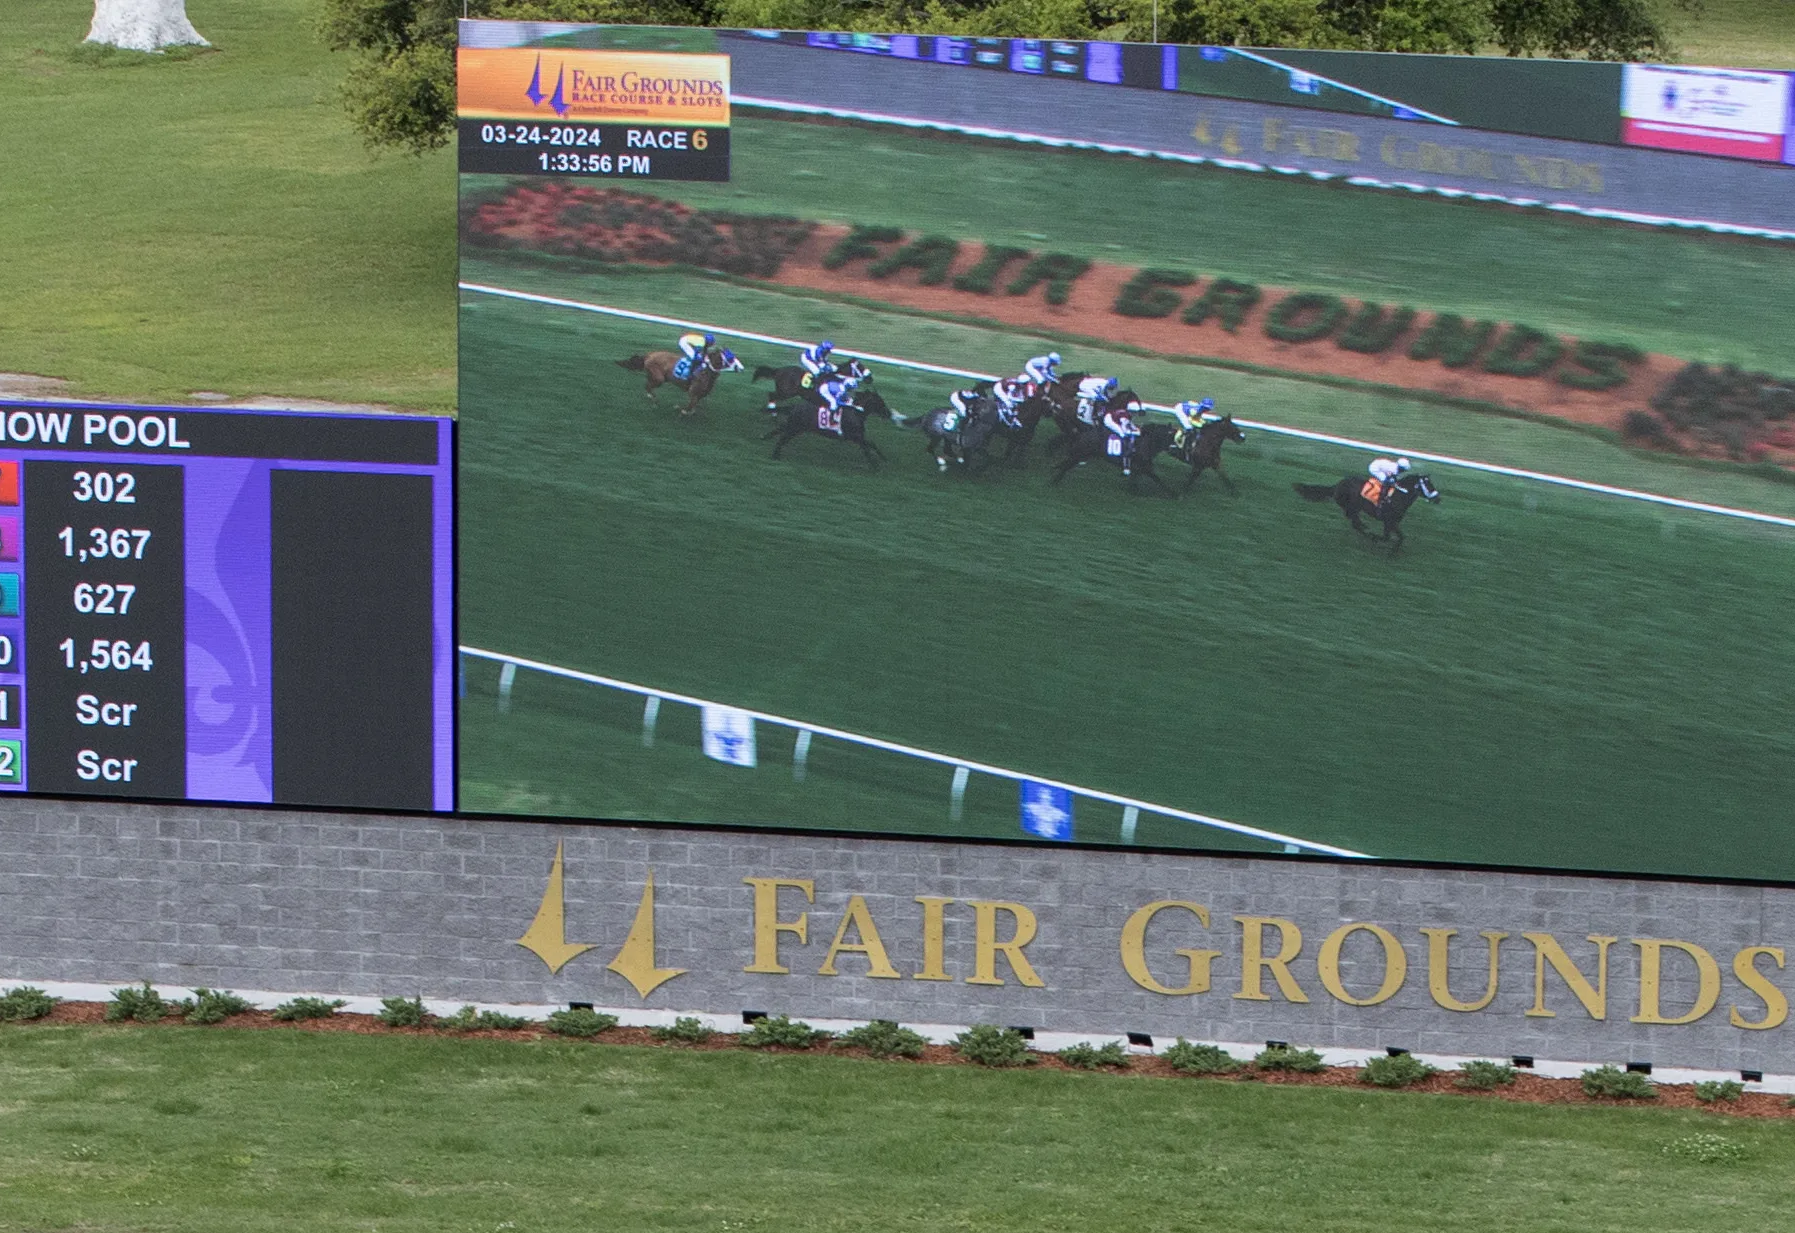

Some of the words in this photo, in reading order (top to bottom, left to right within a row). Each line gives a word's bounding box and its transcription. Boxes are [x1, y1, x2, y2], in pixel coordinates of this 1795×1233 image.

[572, 70, 616, 91] FAIR
[621, 72, 723, 95] GROUNDS
[572, 92, 604, 103] RACE
[611, 94, 662, 106] COURSE
[668, 96, 676, 106] &
[681, 97, 722, 106] SLOTS
[481, 124, 601, 147] 03-24-2024
[626, 129, 688, 150] RACE
[692, 129, 707, 150] 6
[538, 152, 613, 173] 1:33:56
[617, 155, 650, 174] PM
[83, 414, 190, 448] POOL
[73, 471, 135, 503] 302
[58, 526, 151, 563] 1,367
[73, 582, 136, 614] 627
[59, 637, 153, 674] 1,564
[75, 694, 137, 726] Scr
[76, 749, 138, 782] Scr
[744, 878, 1047, 988] FAIR
[1119, 899, 1789, 1030] GROUNDS
